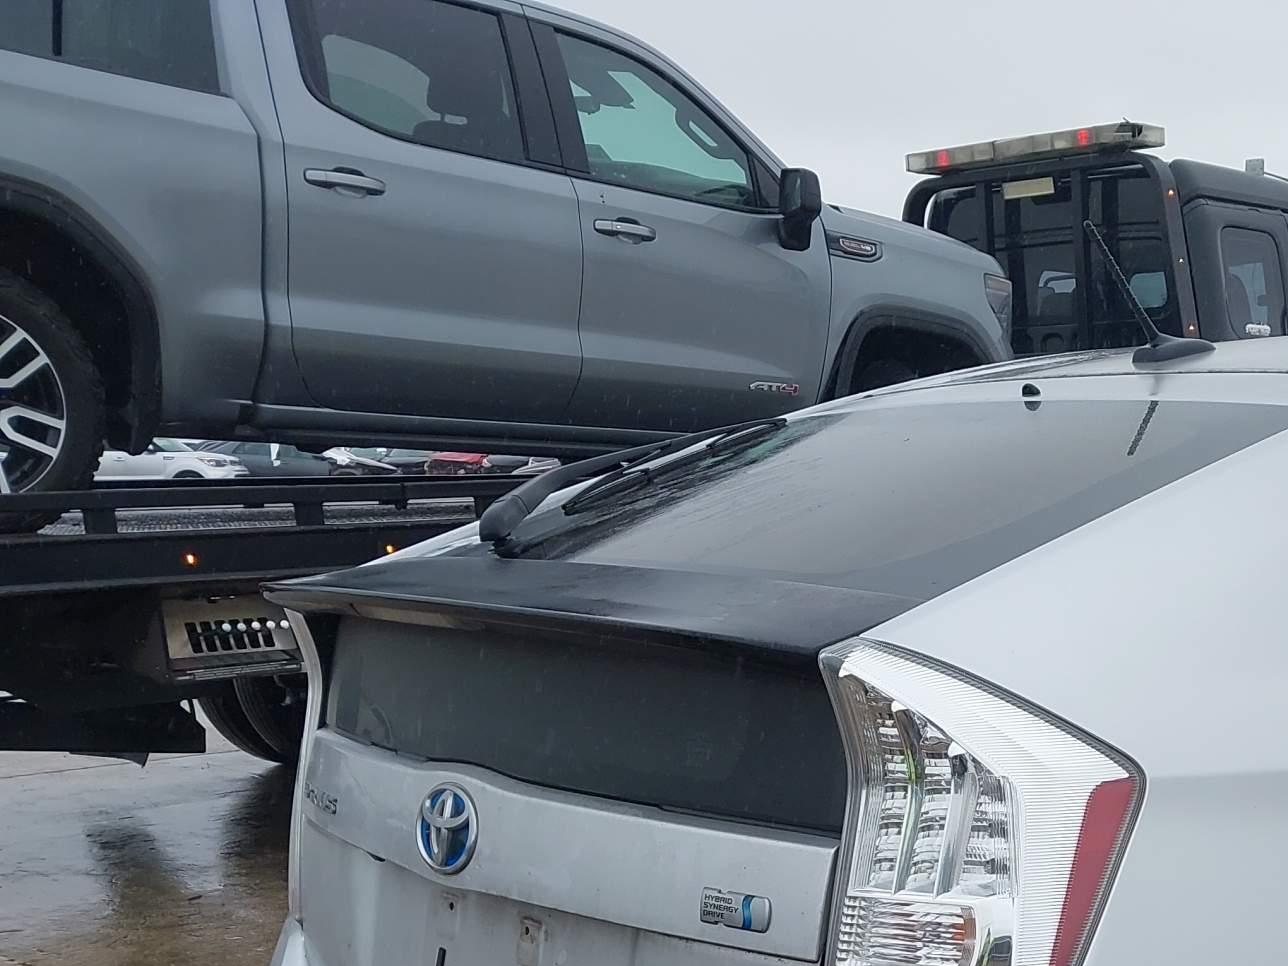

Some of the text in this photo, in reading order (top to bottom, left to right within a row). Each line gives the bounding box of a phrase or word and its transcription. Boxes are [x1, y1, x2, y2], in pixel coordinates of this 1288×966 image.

[749, 380, 800, 396] AT4
[703, 893, 734, 905] HYBRID
[702, 901, 740, 914] SYNERGY
[702, 909, 726, 920] DRIVE
